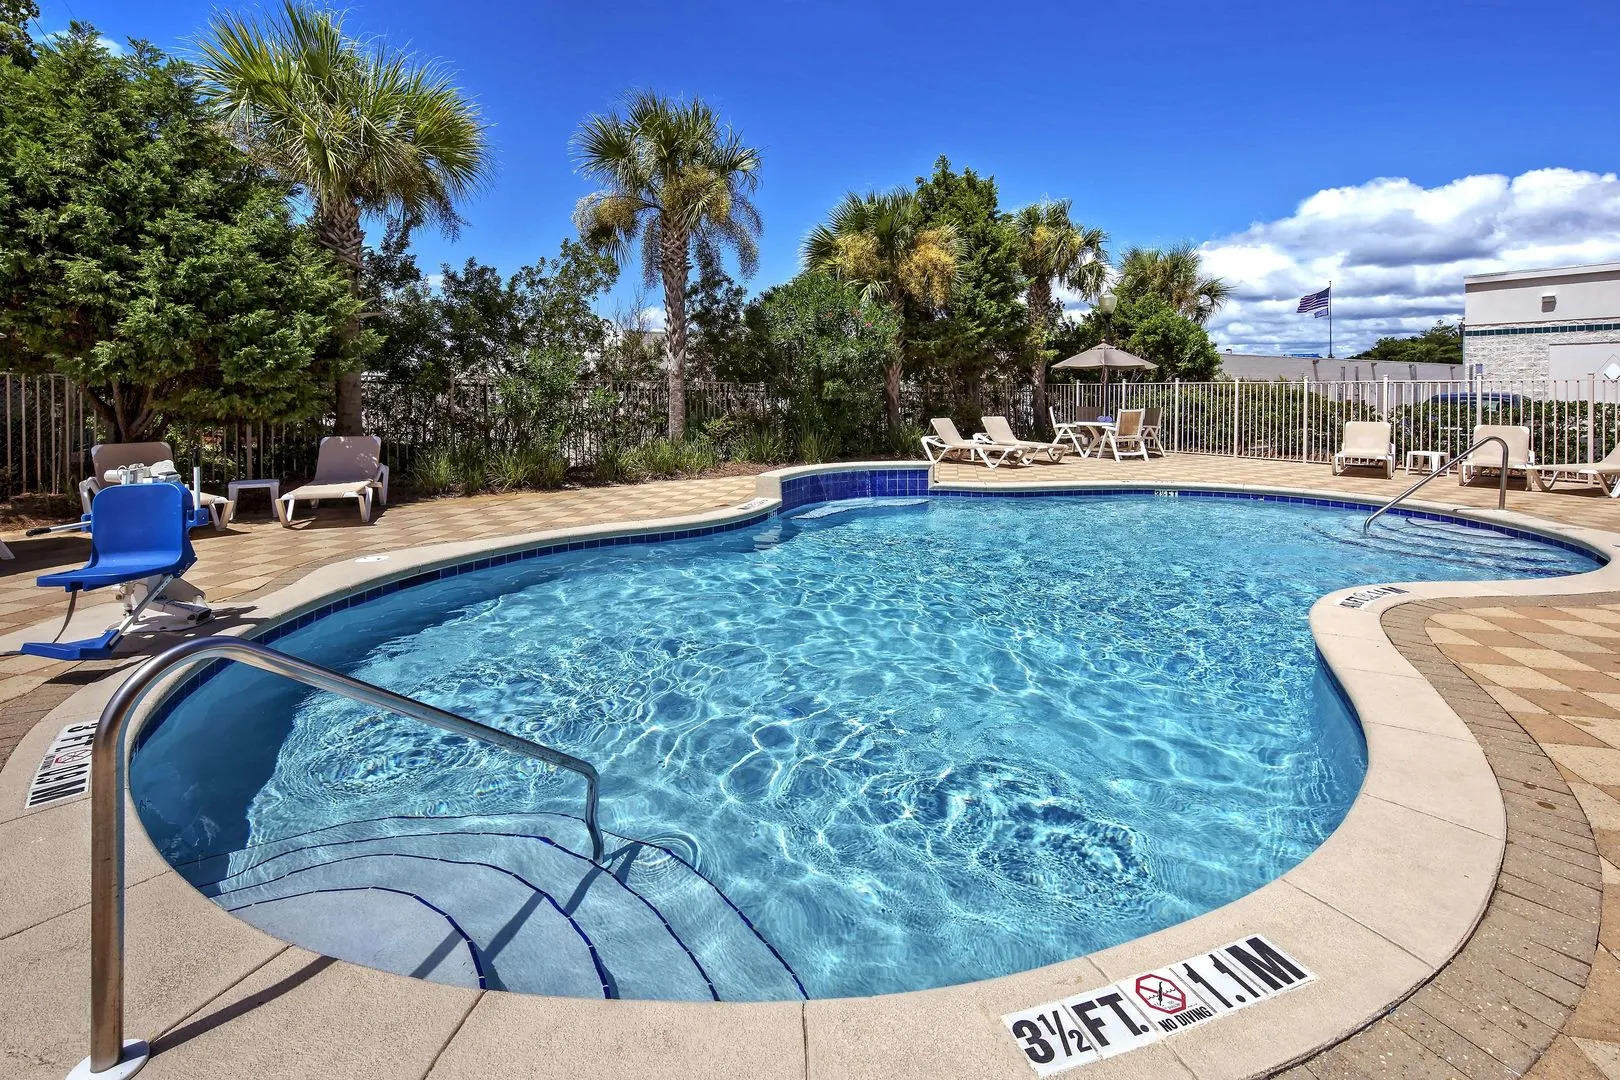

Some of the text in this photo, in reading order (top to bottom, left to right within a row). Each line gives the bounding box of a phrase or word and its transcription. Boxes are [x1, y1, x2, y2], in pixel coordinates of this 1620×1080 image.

[29, 778, 86, 806] M
[1182, 936, 1308, 1009] 1.1 M
[1071, 993, 1150, 1047] FT.
[1157, 1006, 1213, 1033] NO DIVING
